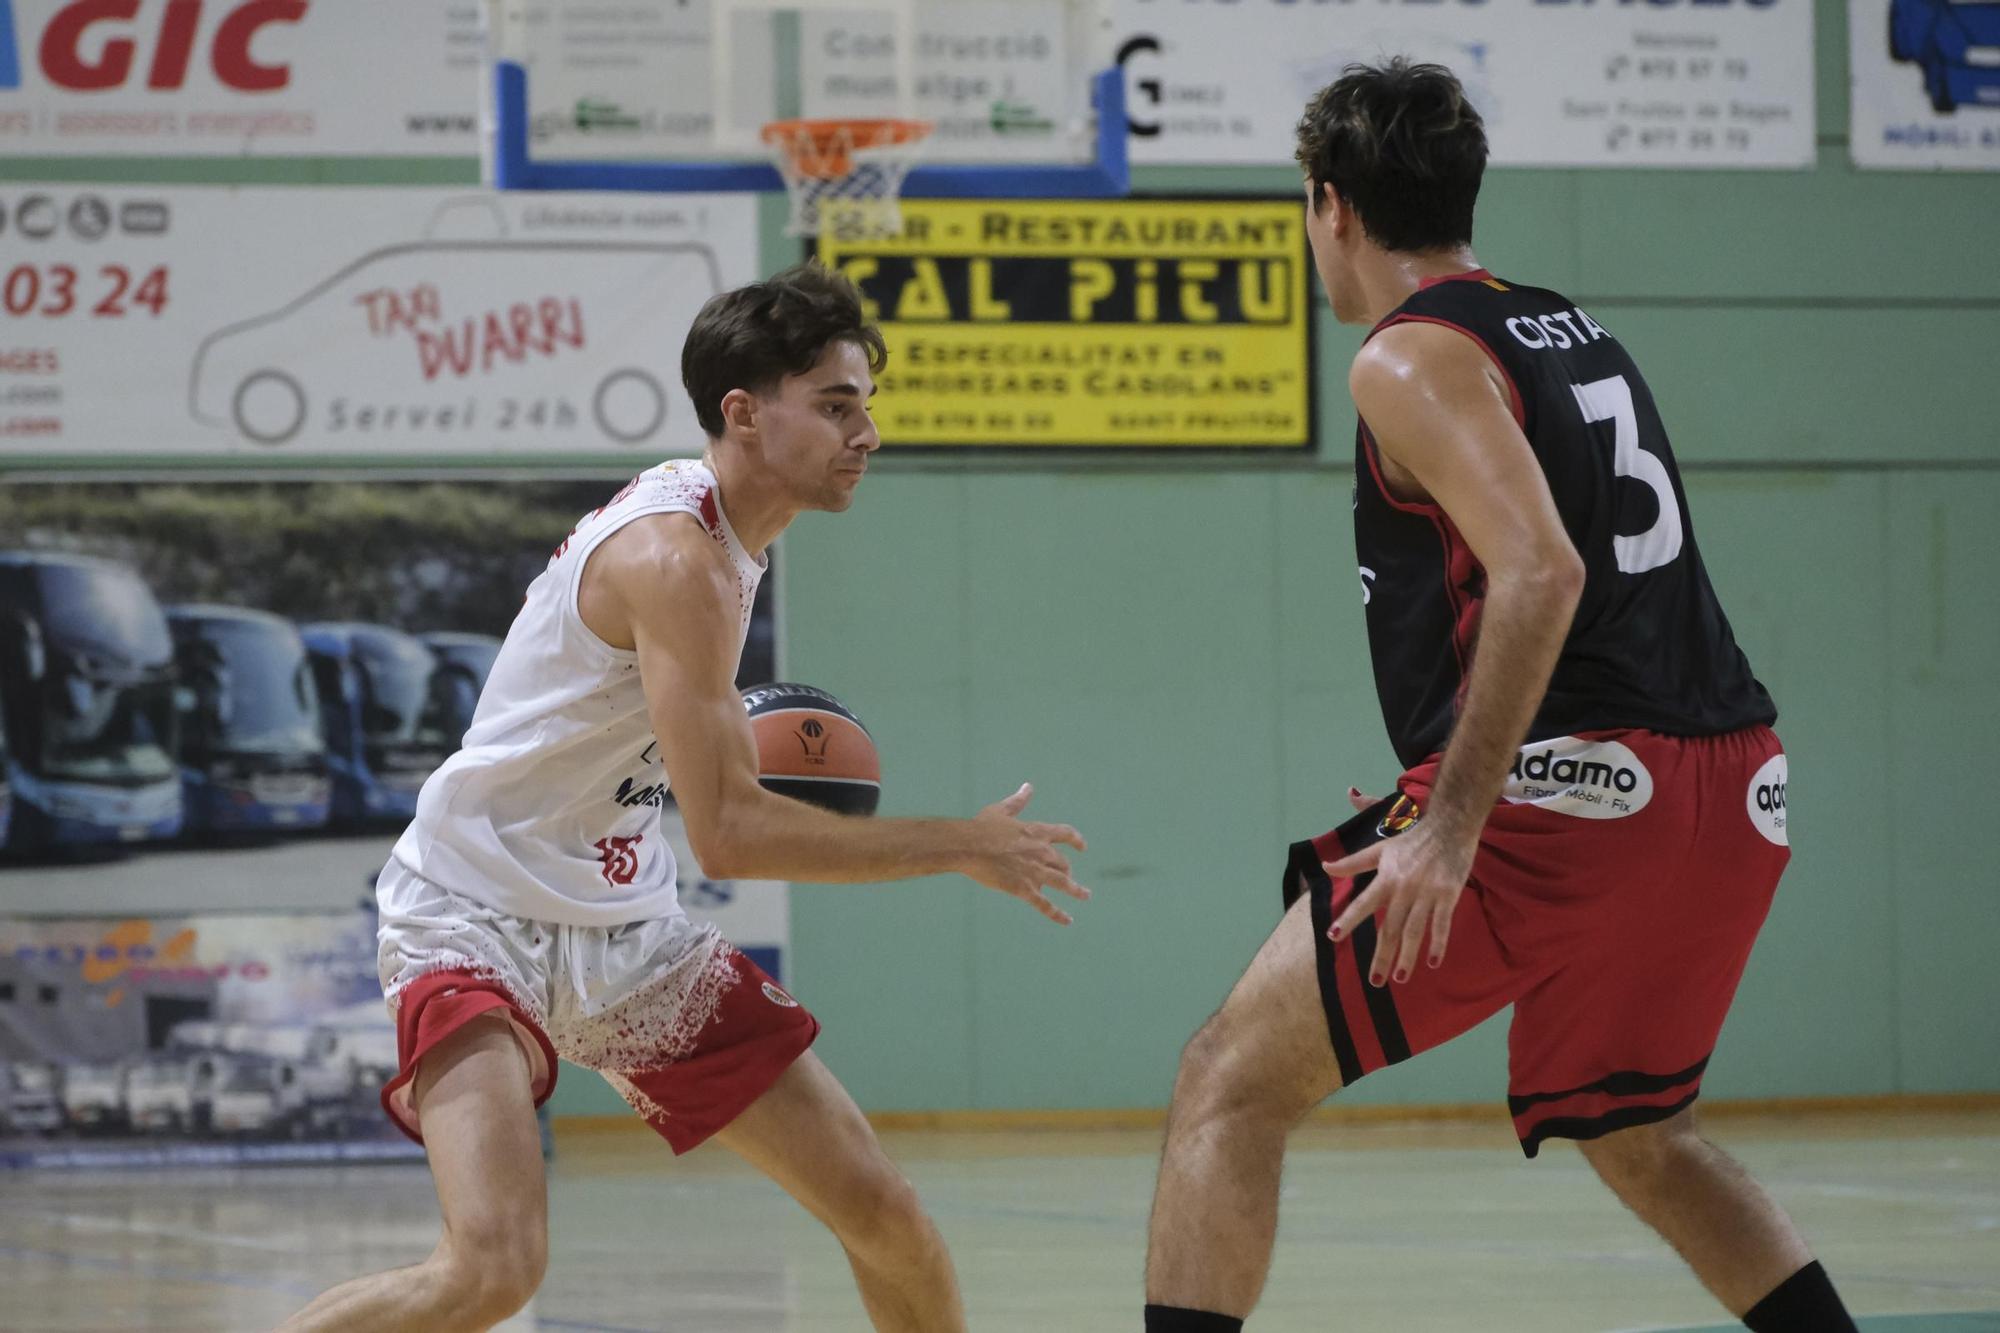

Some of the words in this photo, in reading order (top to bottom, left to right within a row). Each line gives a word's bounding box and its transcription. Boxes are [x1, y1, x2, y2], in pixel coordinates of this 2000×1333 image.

[39, 0, 312, 92] GIC
[981, 212, 1293, 247] RESTAURANT
[4, 263, 78, 317] 03
[91, 263, 170, 317] 24
[413, 297, 586, 380] DUARRI
[1505, 306, 1612, 350] COSTA
[500, 397, 578, 430] 24h
[1570, 374, 1684, 575] 3
[1611, 798, 1631, 813] Fix
